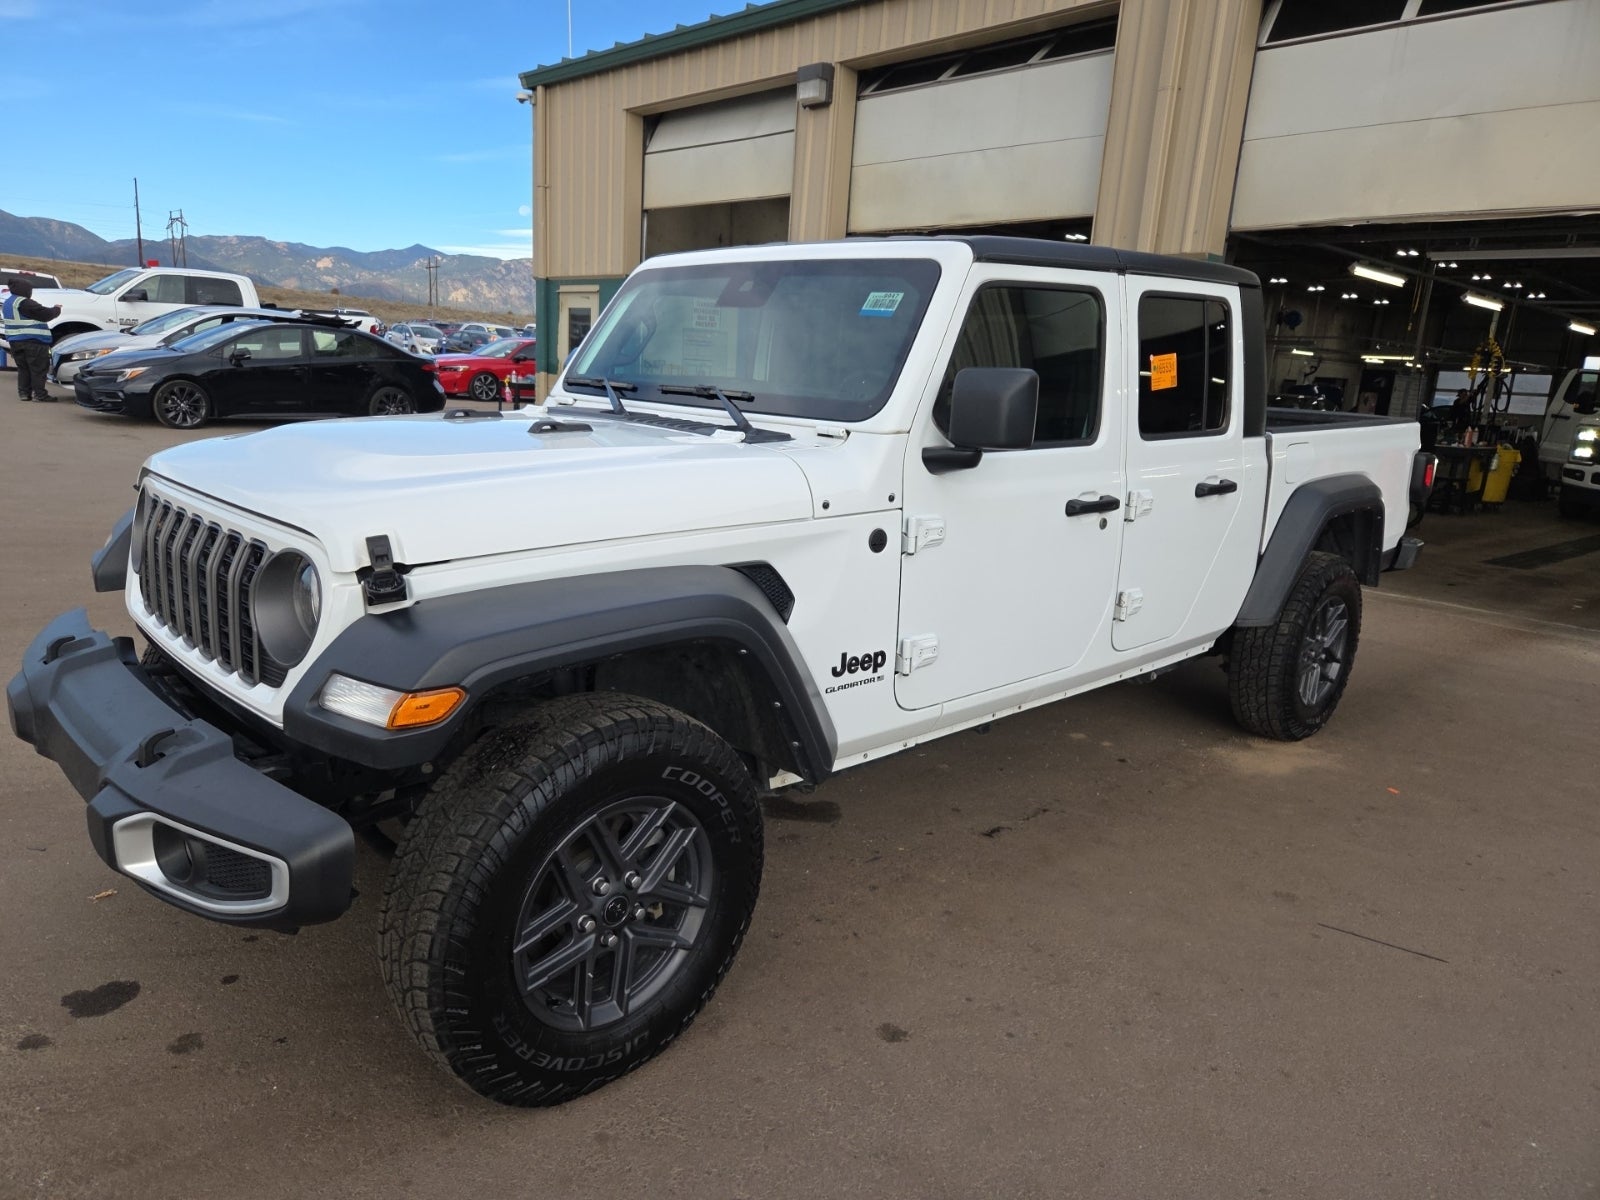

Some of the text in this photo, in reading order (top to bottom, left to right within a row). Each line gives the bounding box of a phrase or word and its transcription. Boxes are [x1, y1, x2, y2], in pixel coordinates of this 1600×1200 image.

[831, 649, 887, 678] Jeep
[825, 676, 876, 694] GLADIATOR
[661, 766, 741, 843] COOPER
